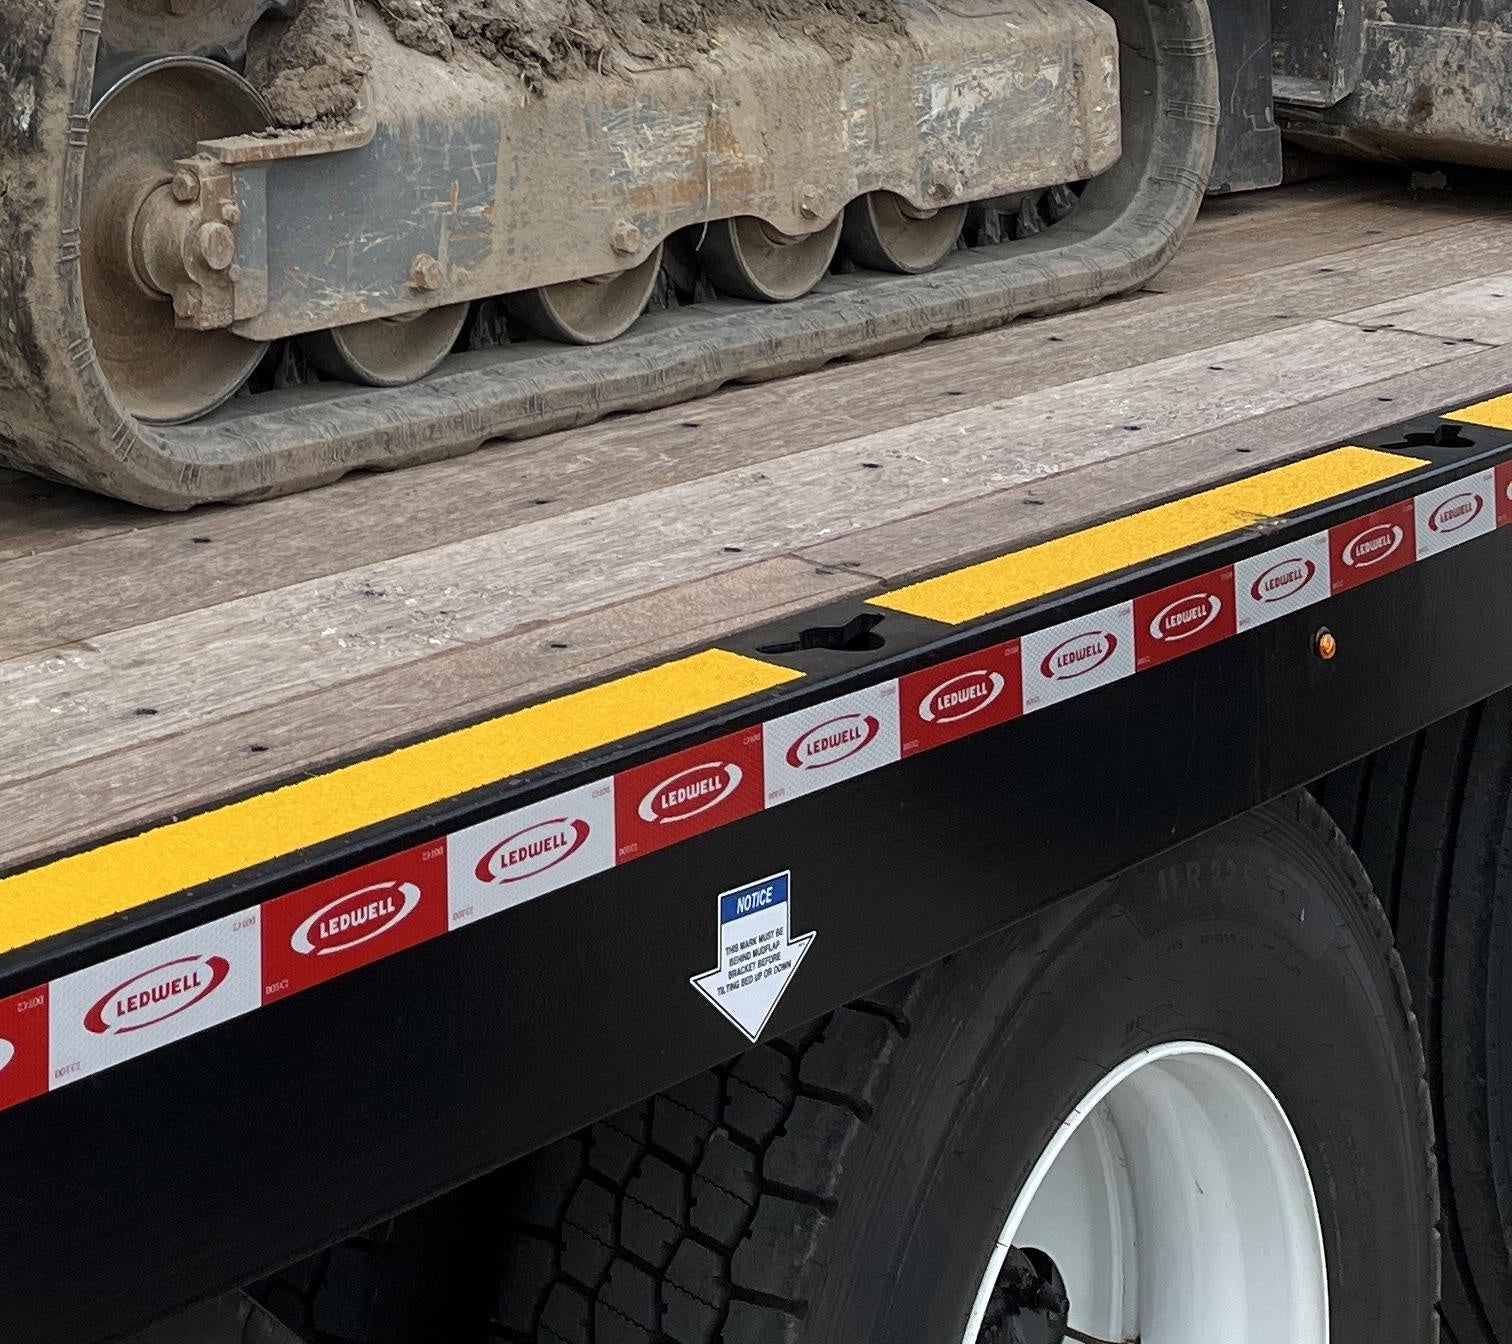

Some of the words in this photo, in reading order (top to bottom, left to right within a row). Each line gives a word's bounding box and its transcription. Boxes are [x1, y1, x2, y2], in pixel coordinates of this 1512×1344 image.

[1165, 604, 1207, 629] LEDWELL
[1057, 642, 1102, 668] LEDWELL
[937, 682, 988, 711] LEDWELL
[807, 726, 861, 756] LEDWELL
[661, 775, 722, 809] LEDWELL
[500, 832, 568, 869] LEDWELL
[737, 886, 773, 914] NOTICE
[320, 896, 395, 939] LEDWELL
[725, 943, 739, 956] THIS
[740, 936, 757, 951] MARK
[758, 930, 774, 946] MUST
[775, 926, 784, 936] BE
[729, 951, 751, 967] BEHIND
[752, 940, 780, 958] MUDFLAP
[728, 961, 756, 980] BRACKET
[757, 952, 781, 972] BEFORE
[754, 971, 763, 983] UP
[764, 967, 773, 979] OR
[773, 960, 791, 975] DOWN
[116, 971, 201, 1017] LEDWELL
